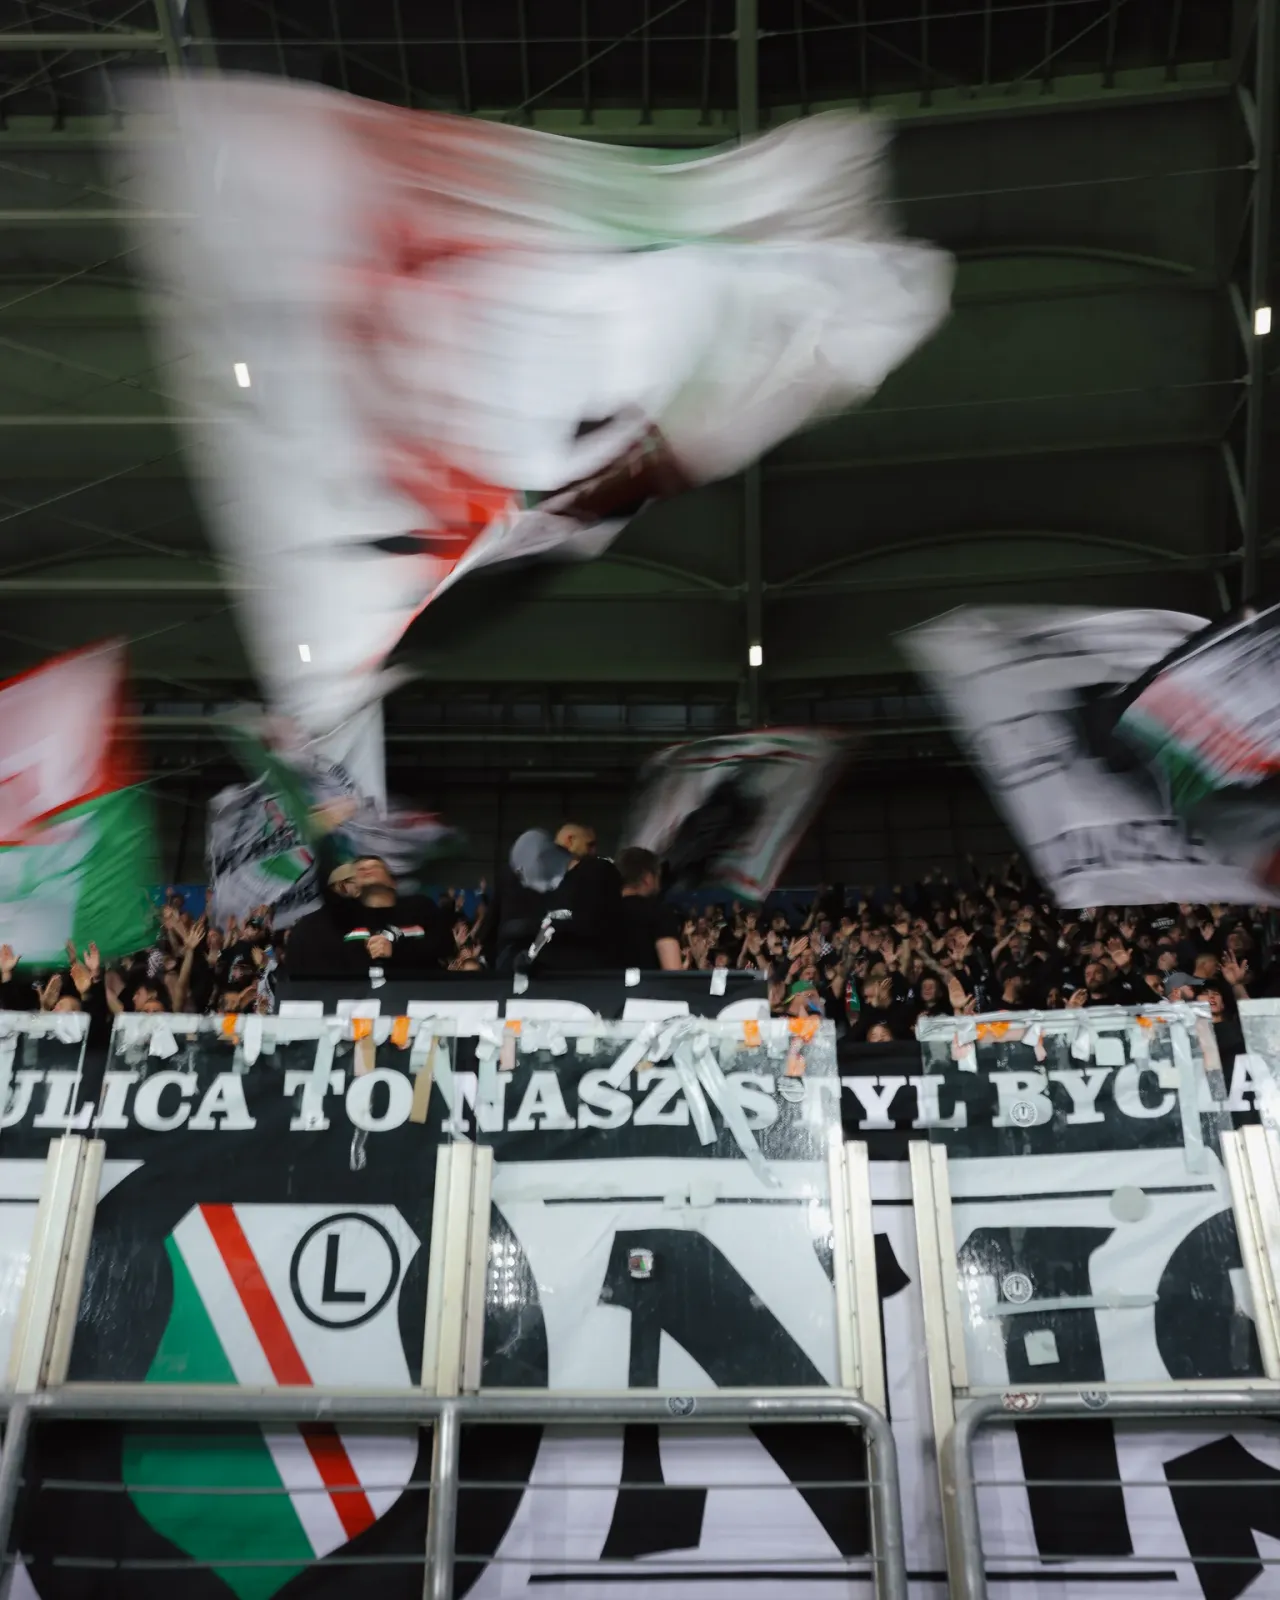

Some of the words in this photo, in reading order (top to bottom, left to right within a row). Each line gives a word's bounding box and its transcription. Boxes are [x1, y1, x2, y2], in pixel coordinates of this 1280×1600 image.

[283, 1067, 414, 1132] TO
[438, 1068, 690, 1133] NASZ
[722, 1071, 967, 1130] STYL
[322, 1234, 366, 1303] L
